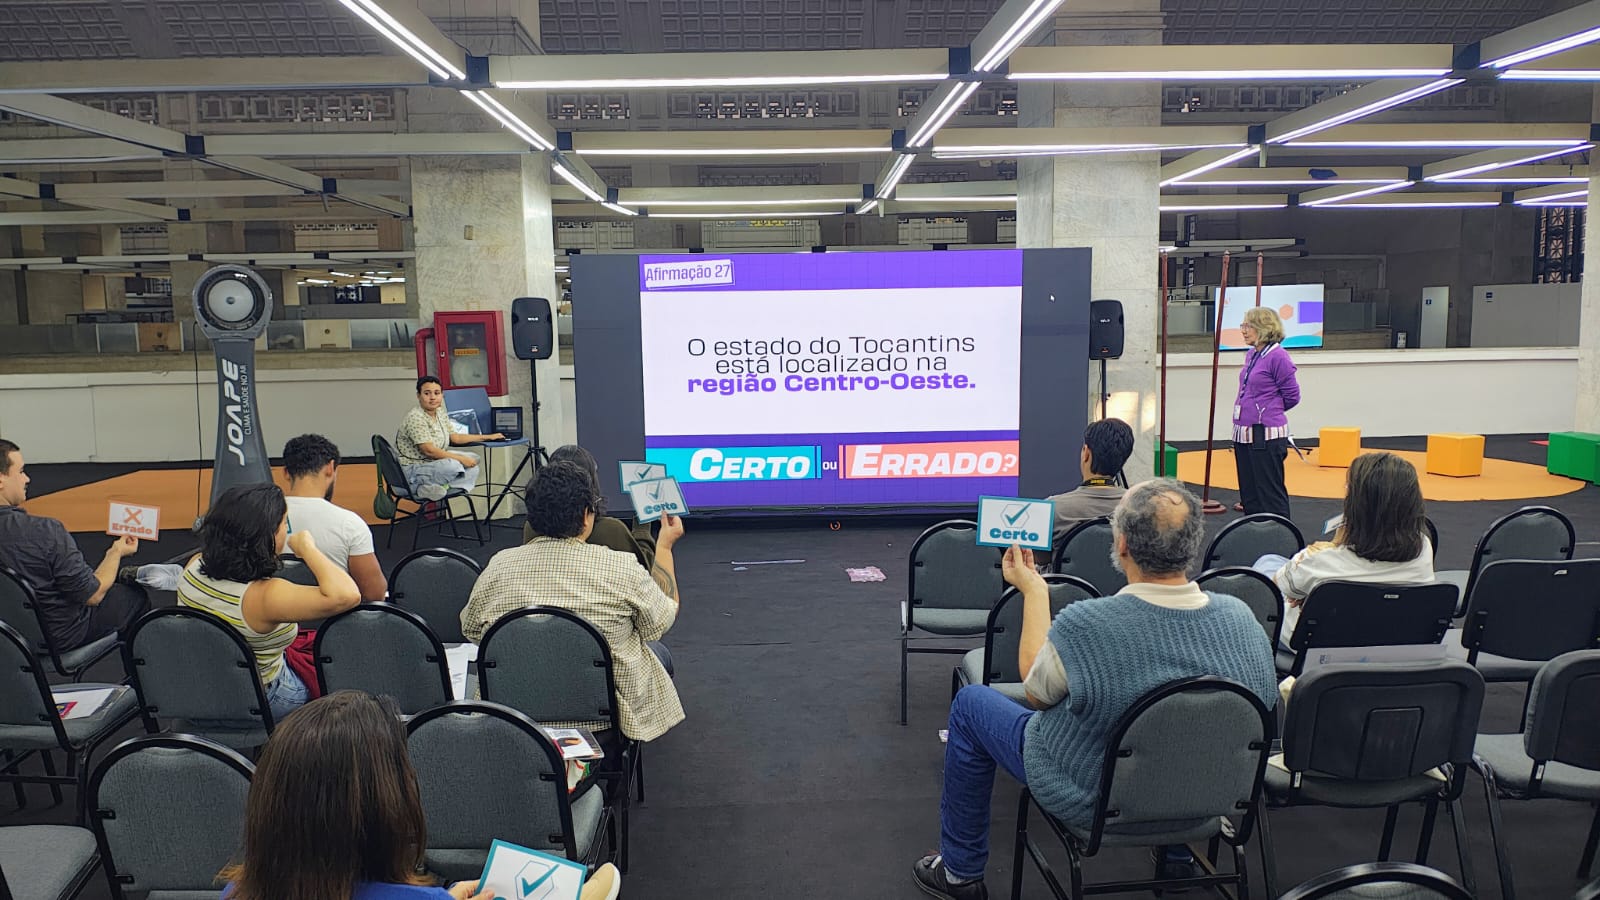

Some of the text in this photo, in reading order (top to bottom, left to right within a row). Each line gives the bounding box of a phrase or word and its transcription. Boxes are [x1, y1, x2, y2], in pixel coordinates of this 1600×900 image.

[646, 264, 730, 281] Afirmação 27
[688, 335, 975, 356] O estado do Tocantins
[239, 365, 247, 374] AR
[716, 354, 947, 374] está localizado na
[240, 374, 248, 385] NO
[688, 372, 976, 395] região Centro-Oeste.
[222, 358, 245, 466] JOAPE
[243, 414, 252, 435] CLIMA
[689, 445, 1017, 480] CERTO ou ERRADO?
[643, 501, 678, 515] Certo
[112, 522, 153, 535] Errado
[989, 527, 1039, 542] Certo
